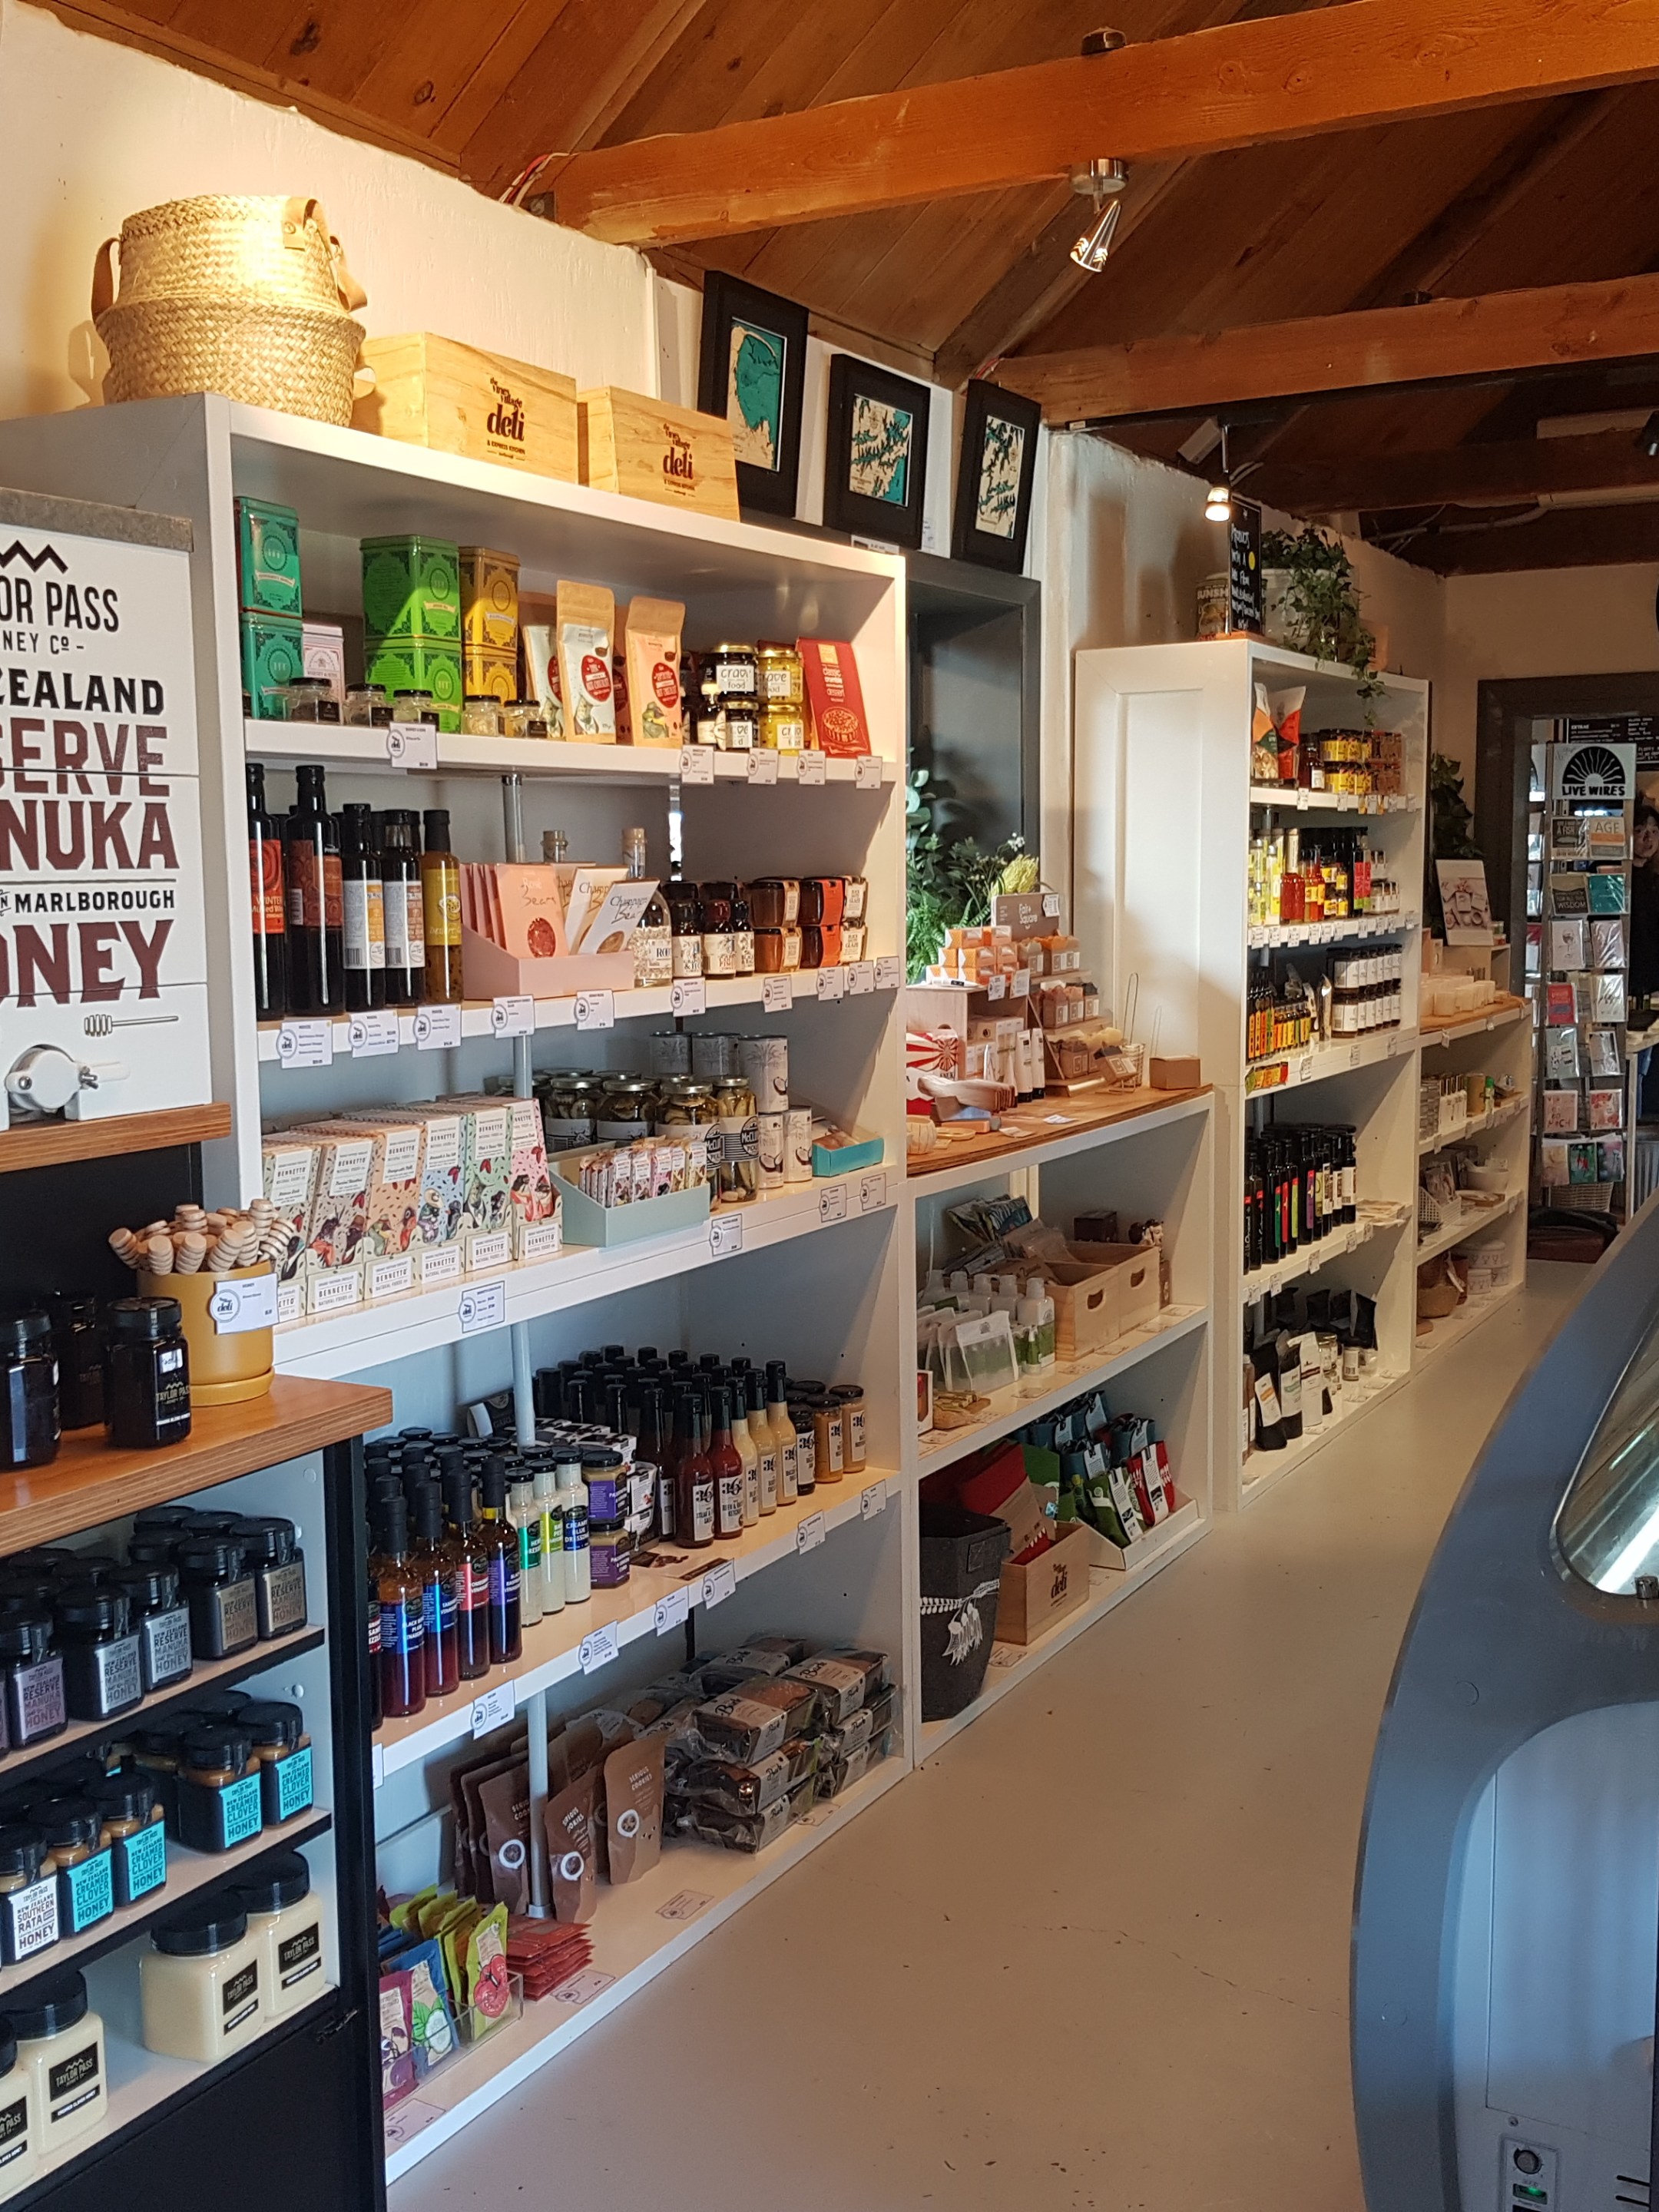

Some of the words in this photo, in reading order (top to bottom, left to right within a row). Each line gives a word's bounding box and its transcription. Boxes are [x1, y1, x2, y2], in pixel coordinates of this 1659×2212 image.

[487, 402, 525, 442] deli
[663, 446, 694, 480] deli
[45, 581, 120, 634] PASS
[0, 667, 164, 716] EALAND
[0, 717, 171, 797] ERVE
[1562, 786, 1587, 796] LIVE
[1589, 786, 1626, 796] WIRES
[1595, 822, 1621, 833] AGE
[14, 889, 176, 914] MARLBOROUGH
[0, 919, 175, 1008] NEY
[431, 1133, 455, 1142] BENNETTO
[479, 1124, 503, 1133] BENNETTO
[389, 1145, 415, 1155] BENNETTO
[277, 1167, 306, 1177] BENNETTO
[338, 1157, 366, 1167] BENNETTO
[475, 1243, 505, 1256] BENNETTO
[528, 1233, 555, 1246] BENNETTO
[425, 1257, 455, 1270] BENNETTO
[376, 1268, 408, 1283] BENNETTO
[318, 1283, 353, 1298] BENNETTO
[217, 1301, 233, 1313] deli
[156, 1389, 178, 1402] TAYLOR
[271, 1581, 302, 1598] RESERVE
[224, 1600, 254, 1615] RESERVE
[154, 1628, 187, 1647] RESERVE
[154, 1637, 188, 1656] MANUKA
[104, 1659, 137, 1677] RESERVE
[156, 1652, 189, 1674] HONEY
[24, 1679, 61, 1701] RESERVE
[107, 1683, 137, 1702] HONEY
[26, 1706, 61, 1729] HONEY
[282, 1767, 310, 1787] CREAMED
[628, 1765, 650, 1783] SERIOUS
[631, 1773, 653, 1792] COOKIES
[282, 1774, 310, 1796] CLOVER
[226, 1798, 237, 1806] NEW
[227, 1793, 258, 1814] CREAMED
[283, 1787, 310, 1811] HONEY
[227, 1801, 258, 1824] CLOVER
[227, 1815, 259, 1839] HONEY
[131, 1848, 142, 1857] NEW
[131, 1842, 163, 1866] CREAMED
[131, 1850, 163, 1875] CLOVER
[75, 1879, 87, 1889] NEW
[76, 1872, 109, 1897] CREAMED
[132, 1865, 164, 1891] HONEY
[17, 1905, 30, 1915] NEW
[31, 1892, 54, 1909] ZEALAND
[76, 1881, 109, 1906] CLOVER
[17, 1898, 55, 1924] SOUTHERN
[78, 1895, 110, 1923] HONEY
[18, 1914, 43, 1934] RATA
[19, 1922, 55, 1950] HONEY
[283, 1944, 303, 1962] TAYLOR
[302, 1936, 315, 1950] PASS
[55, 2068, 78, 2088] TAYLOR
[78, 2058, 94, 2074] PASS
[5, 2113, 22, 2131] PASS
